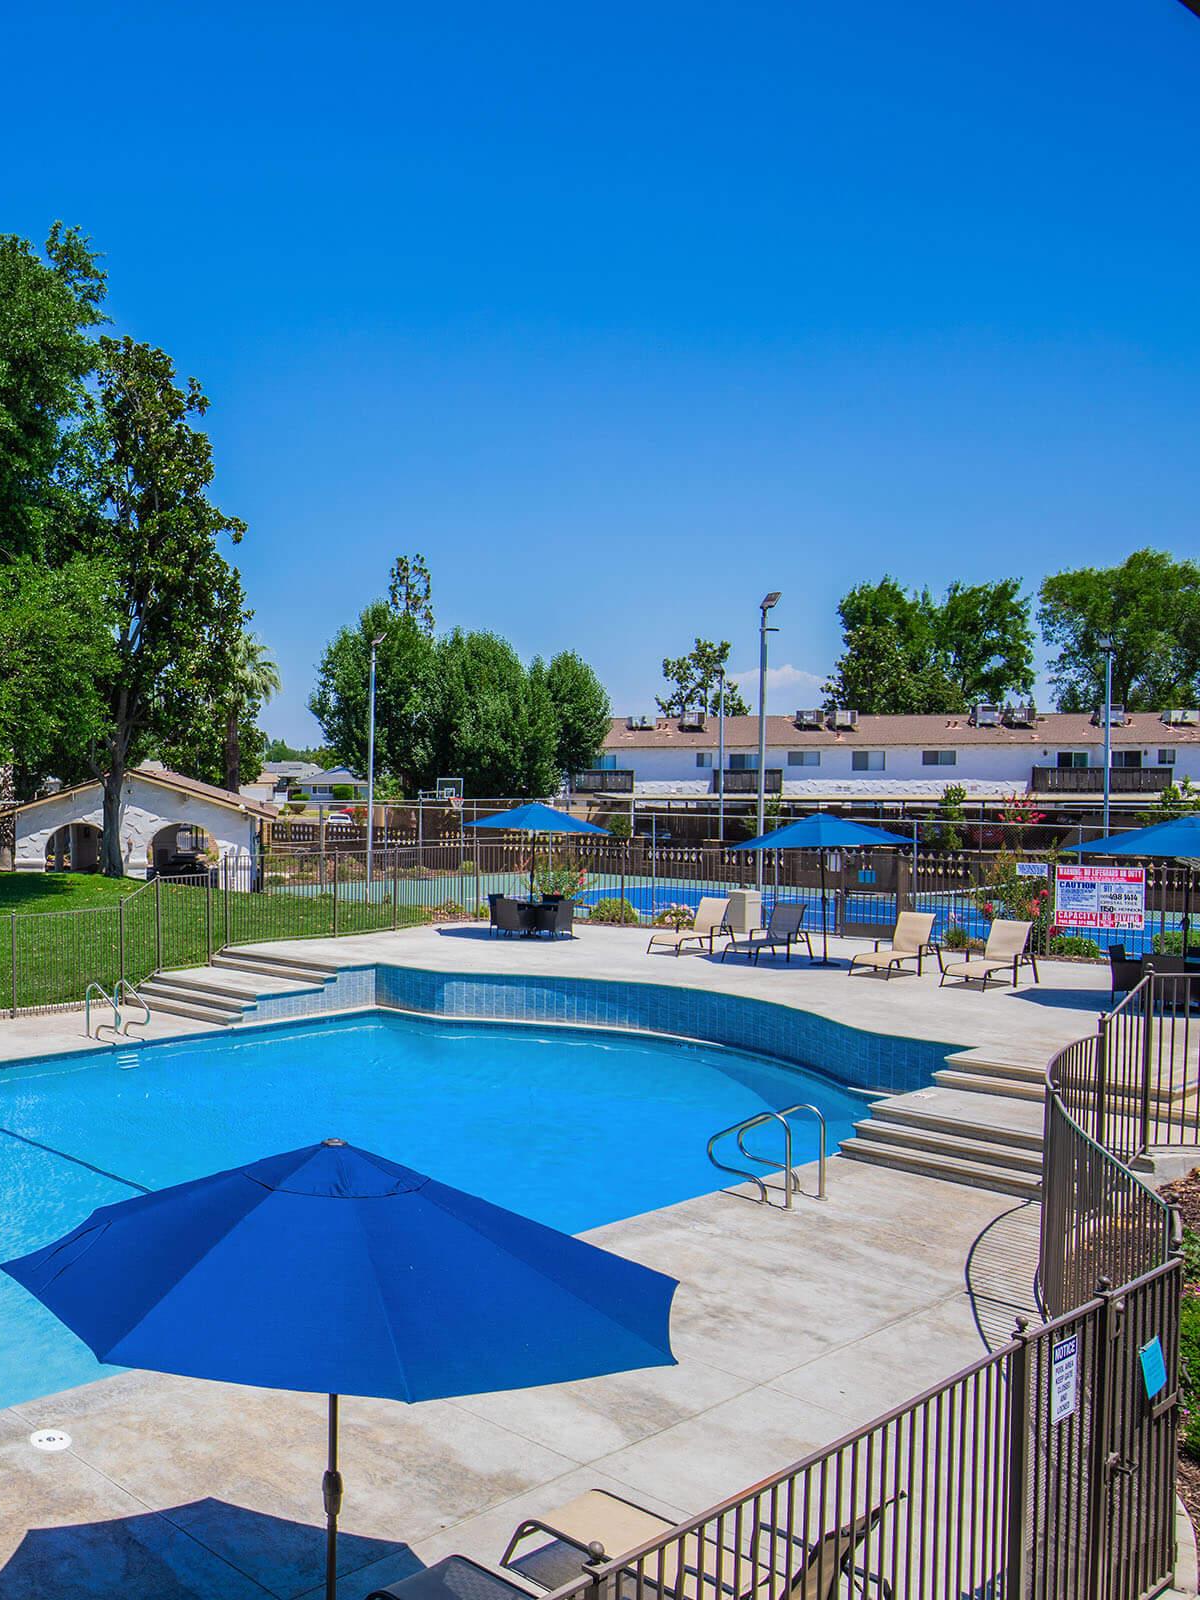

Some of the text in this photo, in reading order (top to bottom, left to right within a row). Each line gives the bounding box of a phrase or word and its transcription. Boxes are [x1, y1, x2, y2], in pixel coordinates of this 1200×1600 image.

[1092, 868, 1119, 877] LIFEGUARD
[1128, 870, 1142, 878] DUTY
[1059, 881, 1096, 889] CAUTION
[1058, 911, 1096, 920] CAPACITY
[1103, 913, 1140, 923] NO DIVING
[1054, 1341, 1076, 1361] NOTICE
